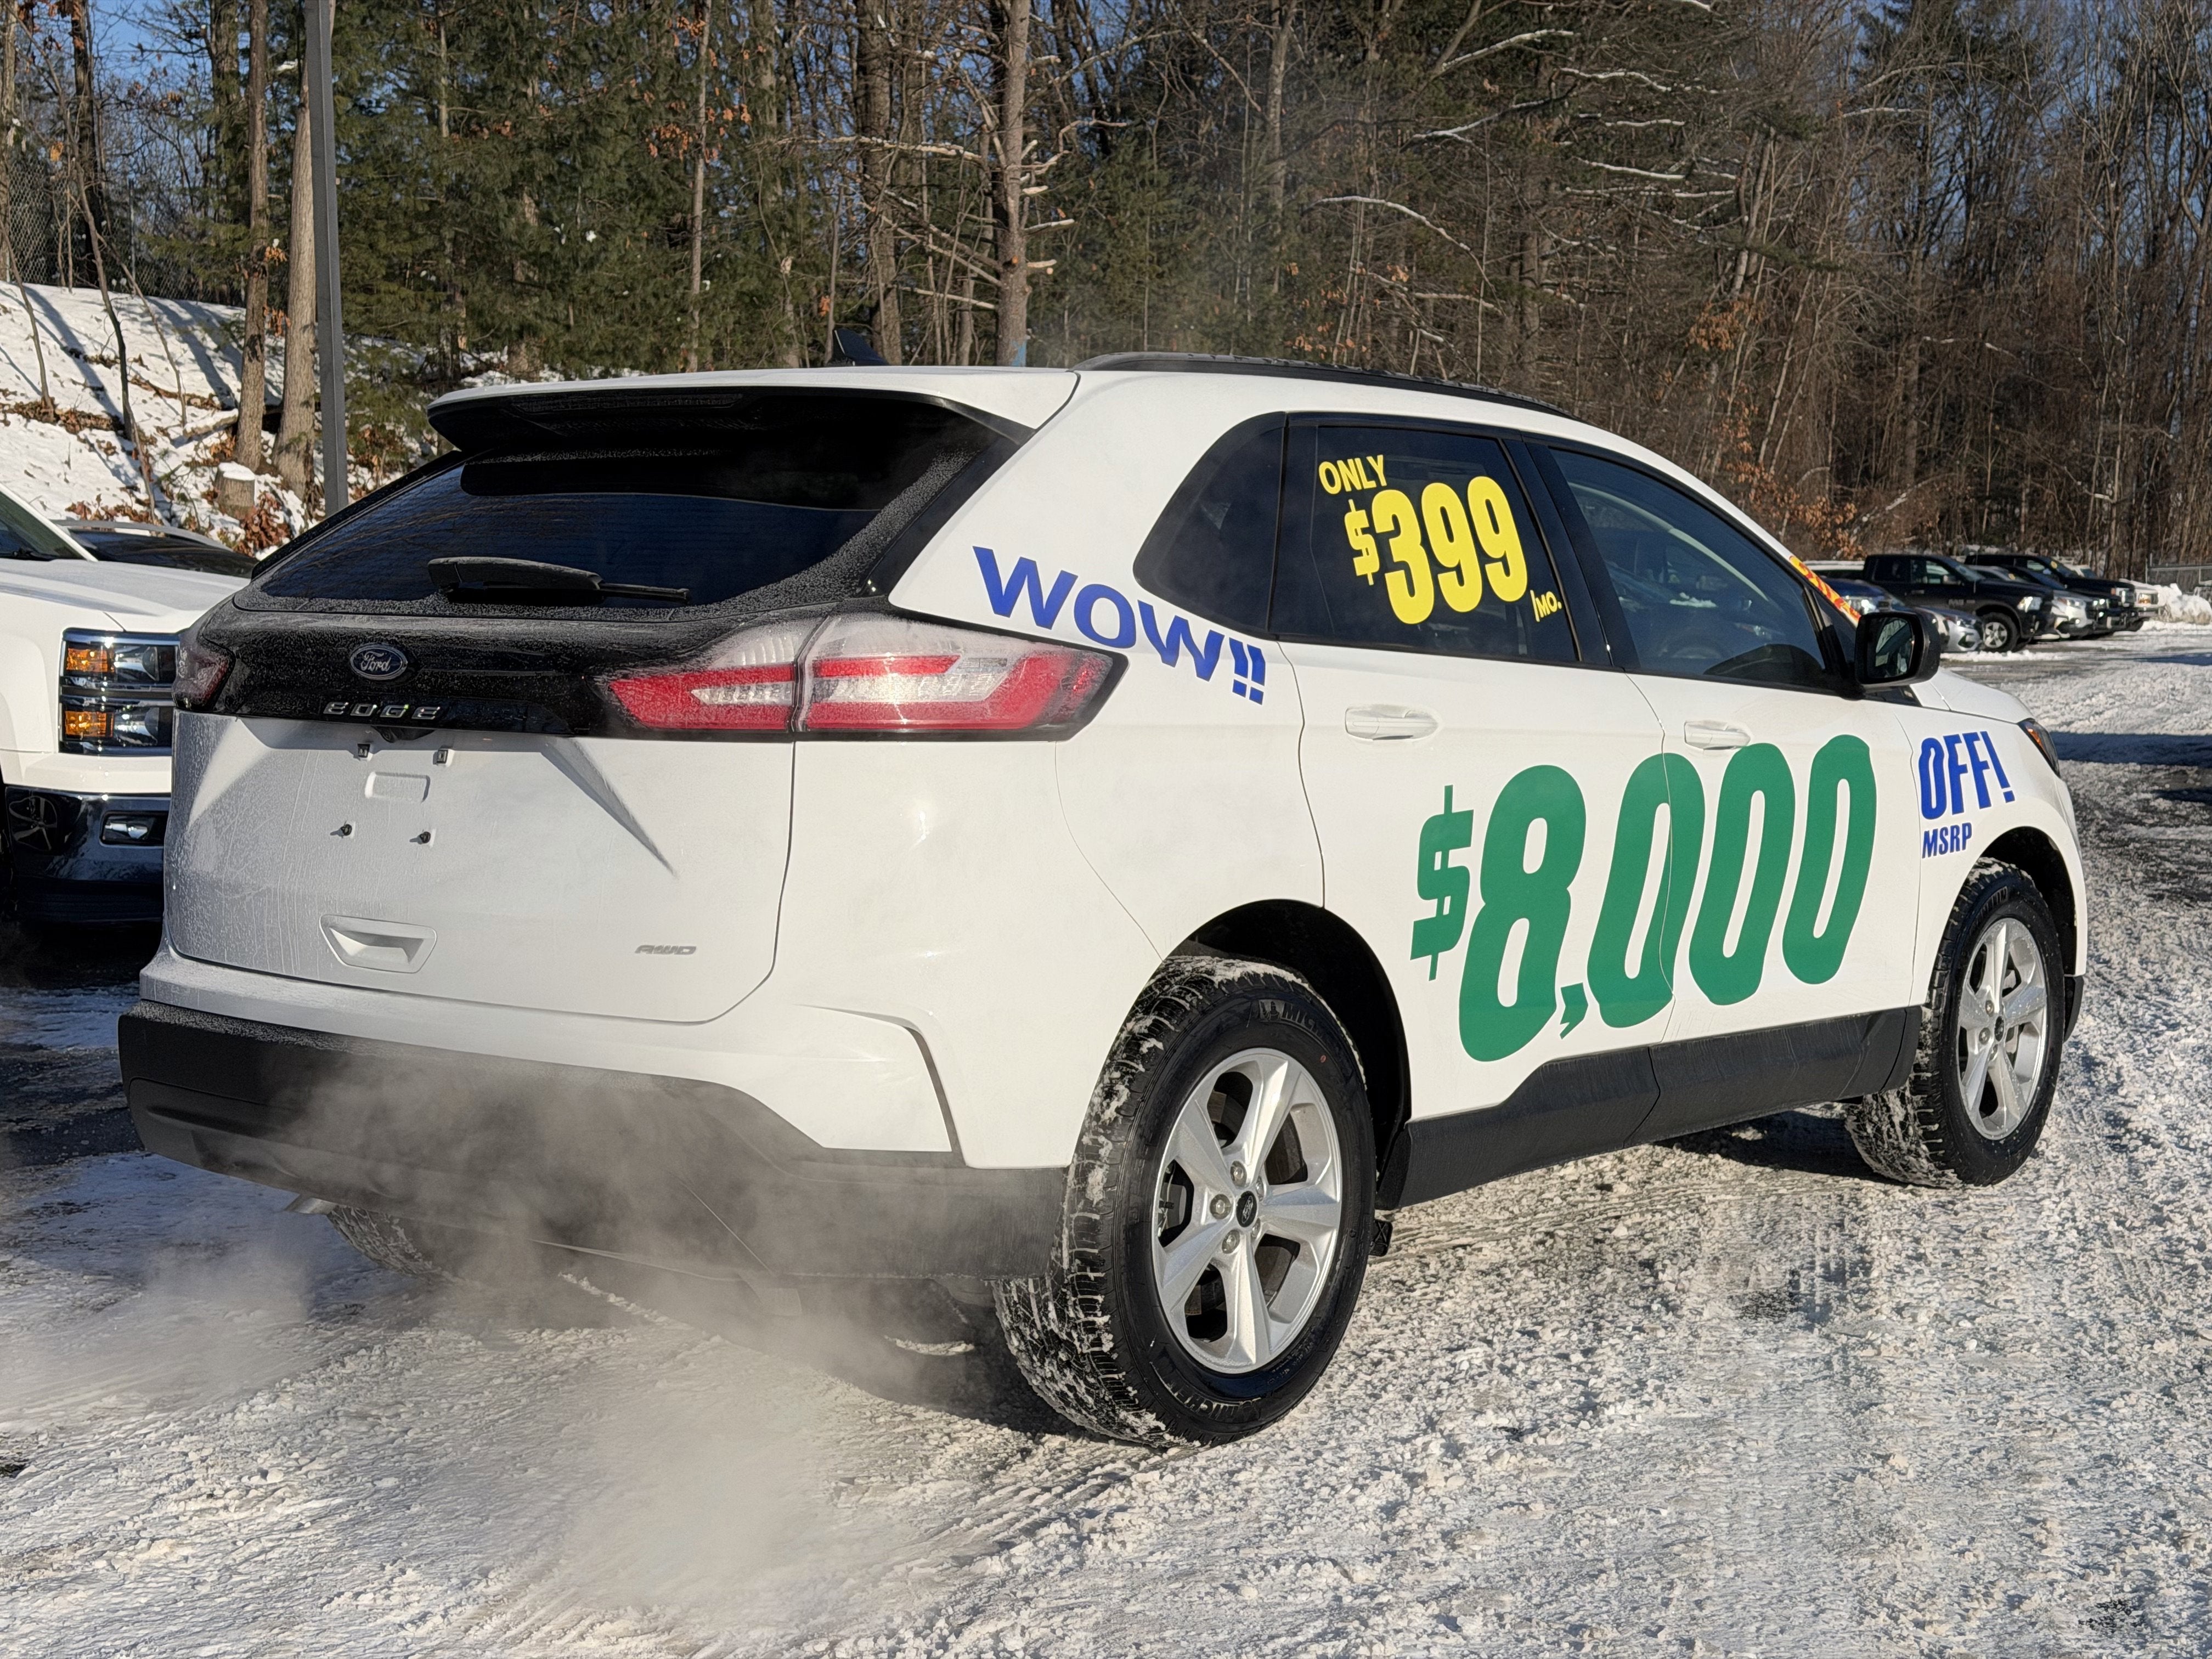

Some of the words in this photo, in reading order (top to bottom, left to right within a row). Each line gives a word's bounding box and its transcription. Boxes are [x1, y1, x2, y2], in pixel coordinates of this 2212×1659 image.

[1318, 455, 1387, 494] ONLY
[1344, 476, 1528, 624] $399
[1530, 590, 1562, 622] /MO.
[972, 545, 1266, 706] WOW!!
[360, 651, 391, 672] Ford
[323, 702, 441, 720] EDGE
[1918, 731, 2016, 820] OFF!
[1922, 822, 1972, 859] MSRP
[1410, 734, 1877, 1062] $8,000
[634, 944, 697, 955] AWD
